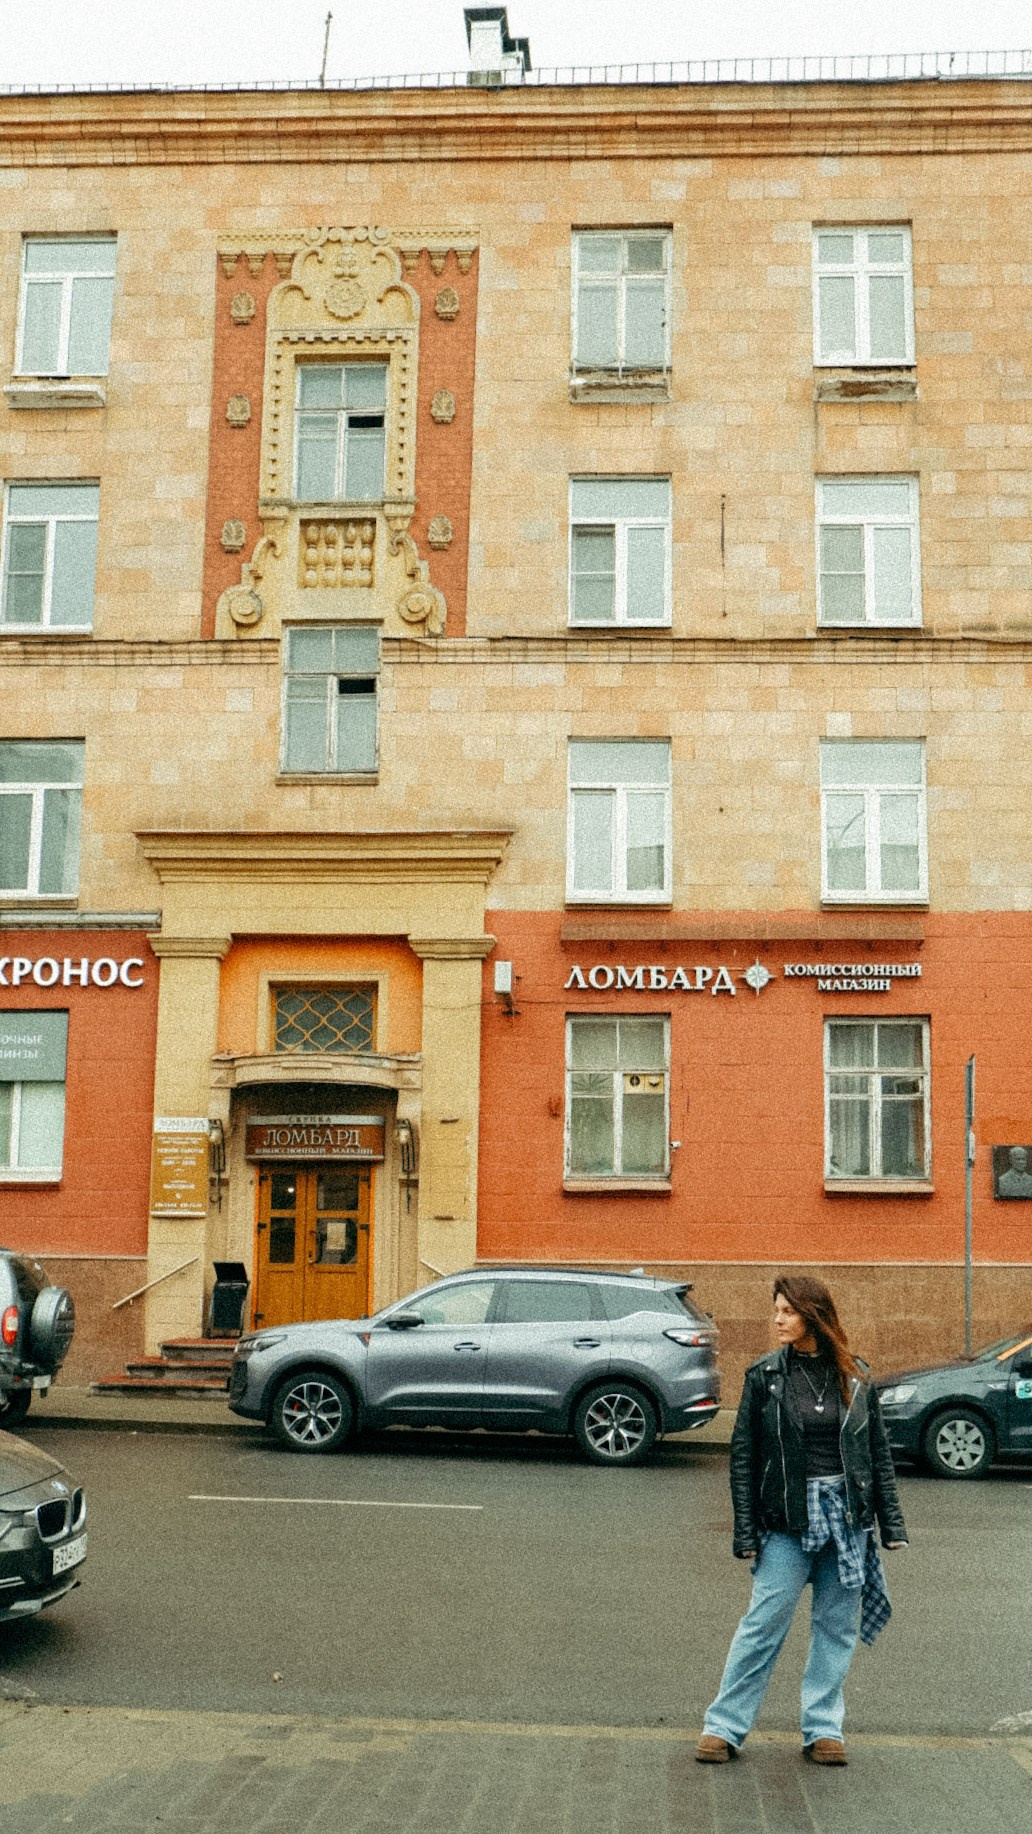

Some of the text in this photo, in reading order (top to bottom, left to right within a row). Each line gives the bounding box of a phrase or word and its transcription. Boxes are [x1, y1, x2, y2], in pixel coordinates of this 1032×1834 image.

[784, 963, 922, 976] КОМИССИОННЫЙ
[564, 965, 736, 995] ЛОМБАРД
[817, 979, 891, 990] МАГАЗИН
[263, 1129, 361, 1147] ЛОМБАРД
